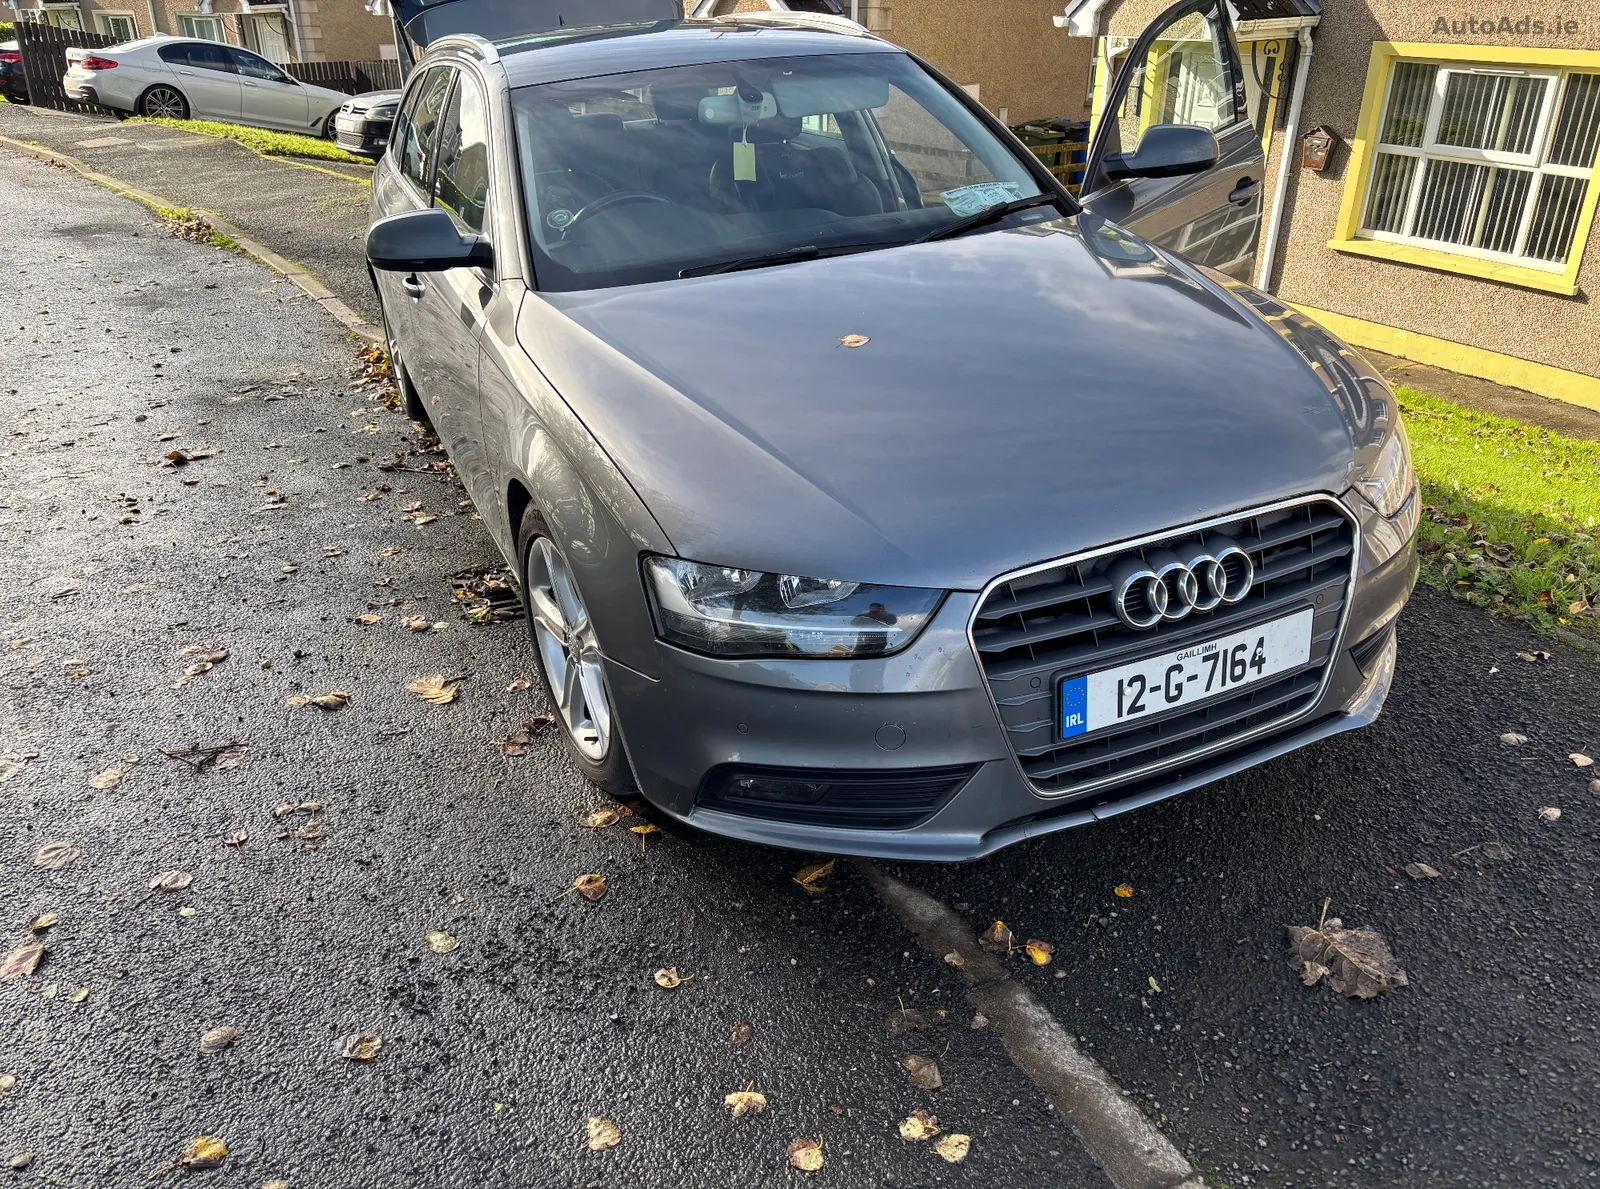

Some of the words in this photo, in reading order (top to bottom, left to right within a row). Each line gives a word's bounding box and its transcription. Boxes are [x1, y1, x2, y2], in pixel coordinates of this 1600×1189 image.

[1176, 643, 1218, 662] GAILLIMH
[1117, 636, 1266, 718] 12-G-7164
[1066, 713, 1085, 728] IRL
